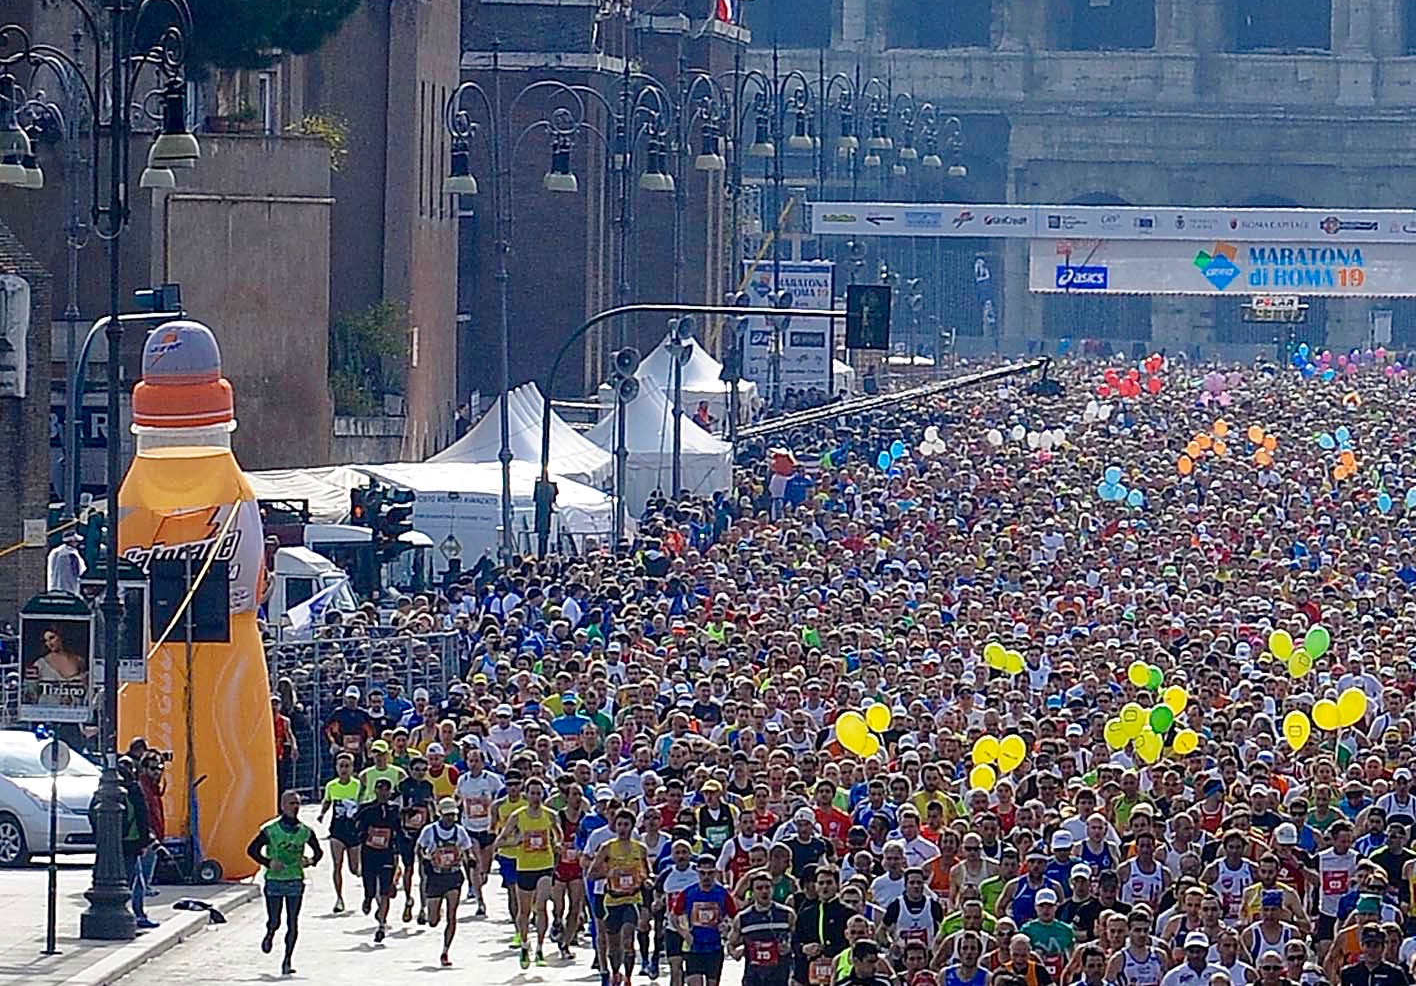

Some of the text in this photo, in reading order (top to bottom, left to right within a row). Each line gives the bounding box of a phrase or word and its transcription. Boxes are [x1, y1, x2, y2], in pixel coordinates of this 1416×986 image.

[1249, 247, 1364, 267] MARATONA
[1249, 267, 1365, 288] di ROMA 19
[1255, 298, 1295, 308] POLAR
[39, 682, 85, 697] Tiziano
